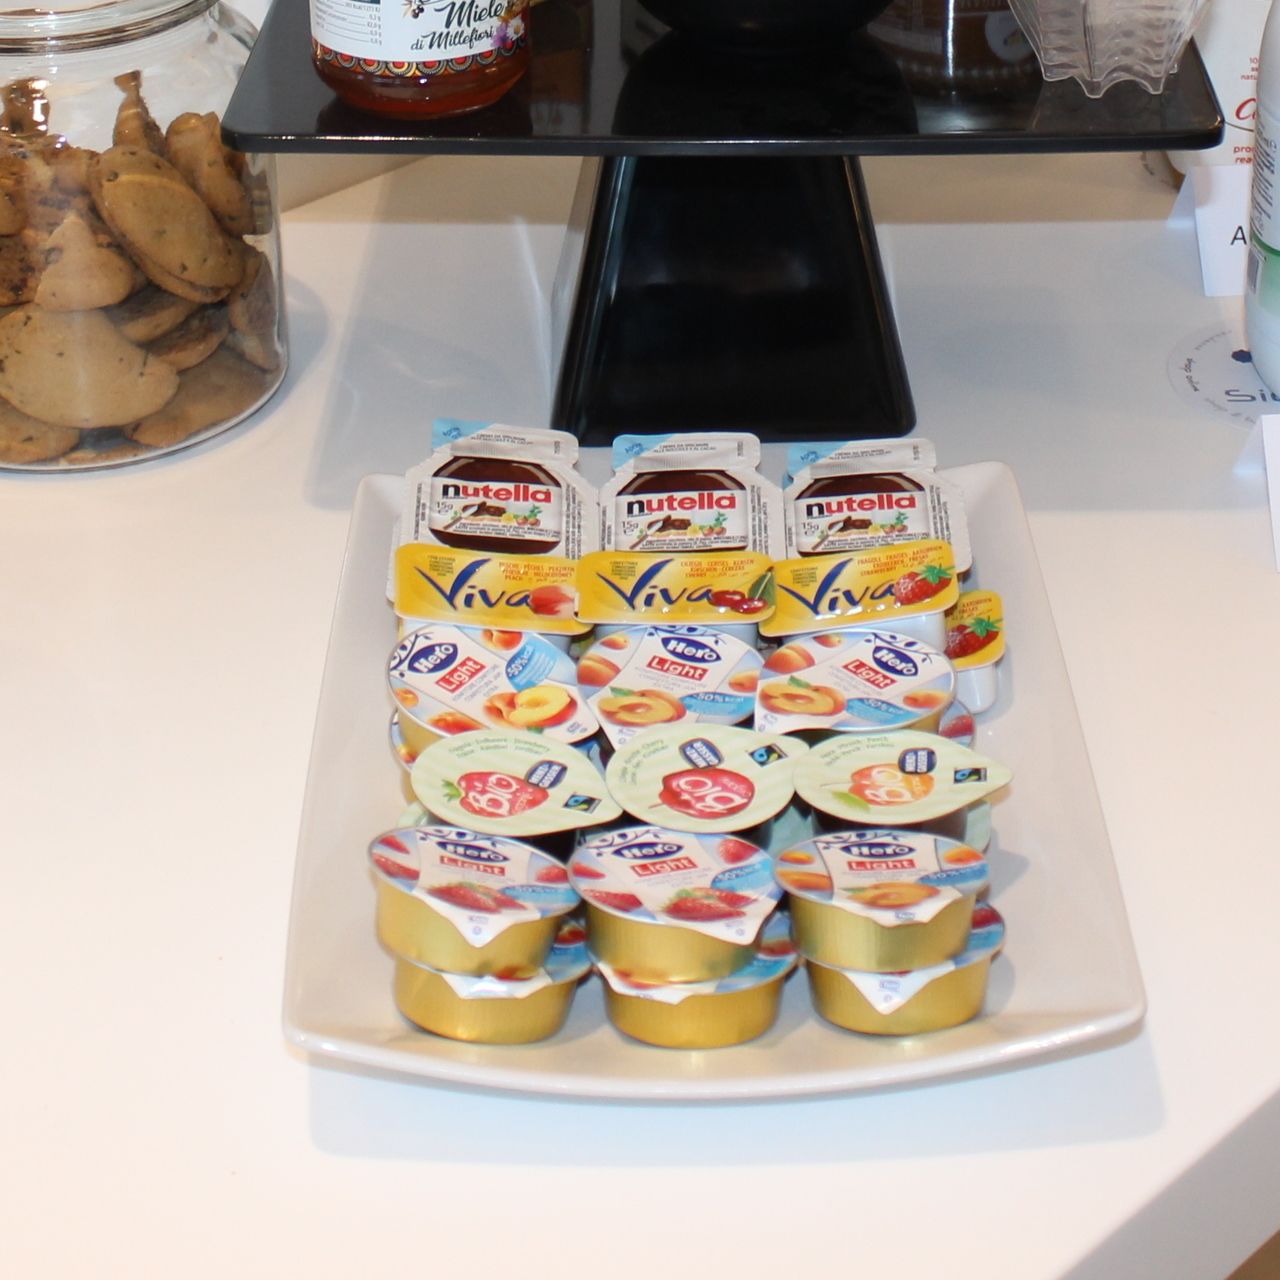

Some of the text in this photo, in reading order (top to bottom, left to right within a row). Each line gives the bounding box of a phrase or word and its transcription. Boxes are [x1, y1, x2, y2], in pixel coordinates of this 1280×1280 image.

[410, 25, 493, 51] di Millefiori
[442, 484, 552, 504] nutella
[627, 492, 737, 515] nutella
[806, 494, 917, 517] nutella
[414, 558, 533, 611] Viva
[596, 558, 714, 610] Viva
[777, 558, 896, 615] Viva
[413, 644, 454, 673] Hero
[667, 639, 718, 661] Hero
[651, 658, 704, 679] Light
[848, 661, 891, 687] Light
[874, 649, 916, 676] Hero
[438, 659, 481, 690] Light
[445, 843, 504, 862] Hero
[622, 844, 677, 859] Hero
[850, 845, 908, 857] Hero
[442, 857, 504, 876] Light
[634, 858, 693, 876] Light
[850, 860, 914, 871] Light
